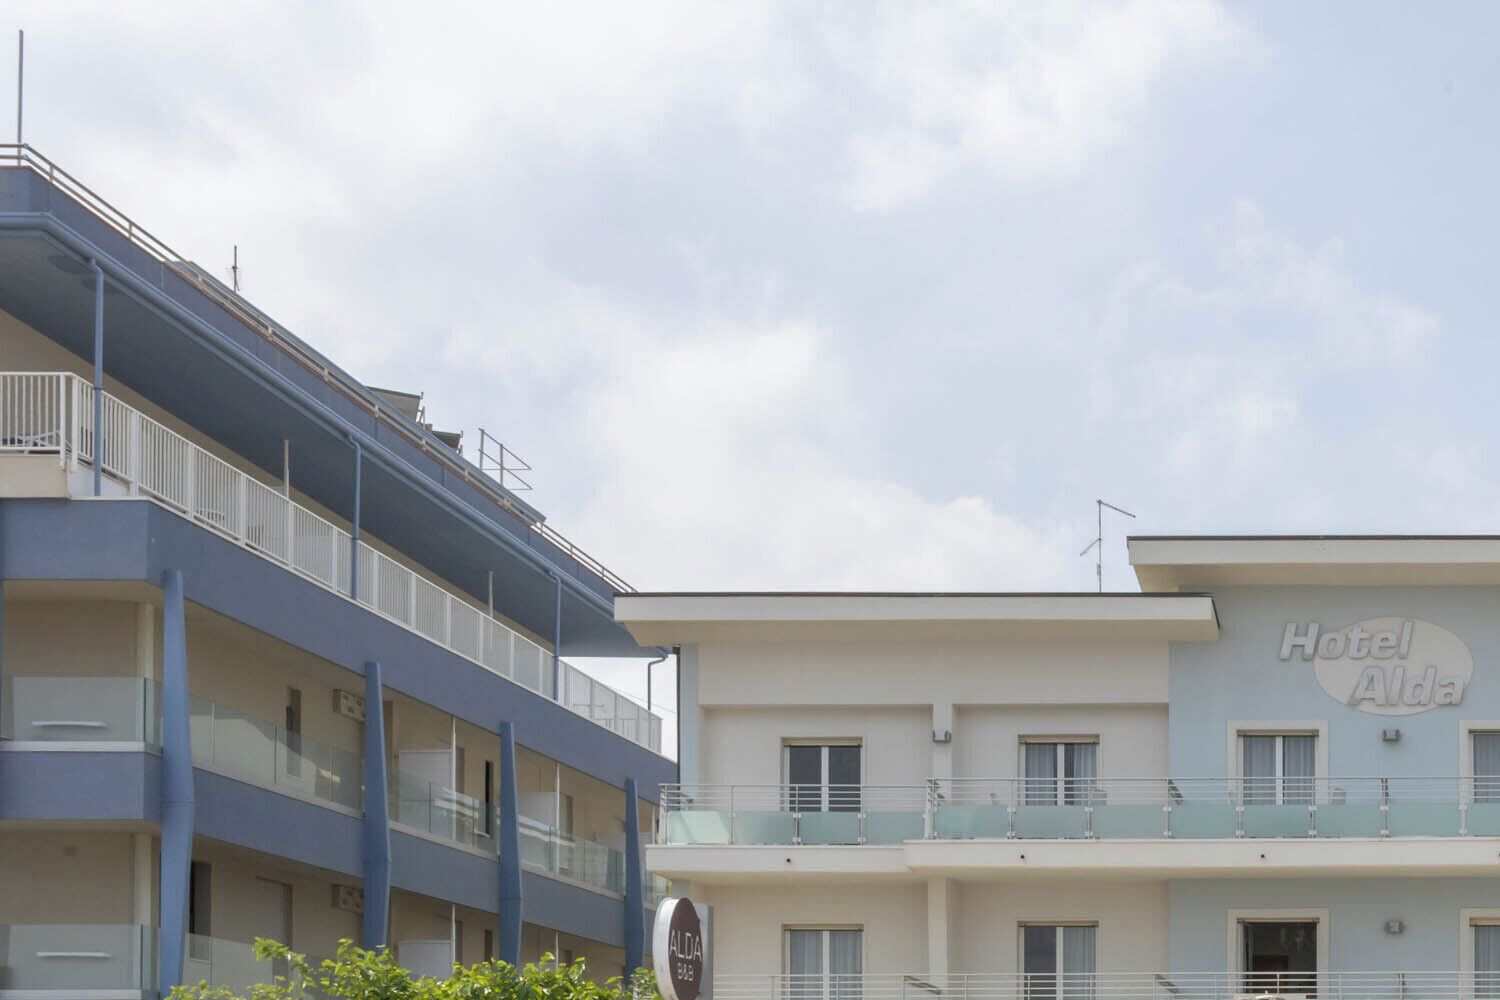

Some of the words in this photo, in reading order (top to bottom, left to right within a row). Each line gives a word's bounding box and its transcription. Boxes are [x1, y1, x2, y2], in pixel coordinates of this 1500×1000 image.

[1279, 621, 1413, 660] Hotel
[1347, 666, 1466, 706] Alda
[670, 929, 702, 961] ALDA
[677, 962, 694, 981] B&B
